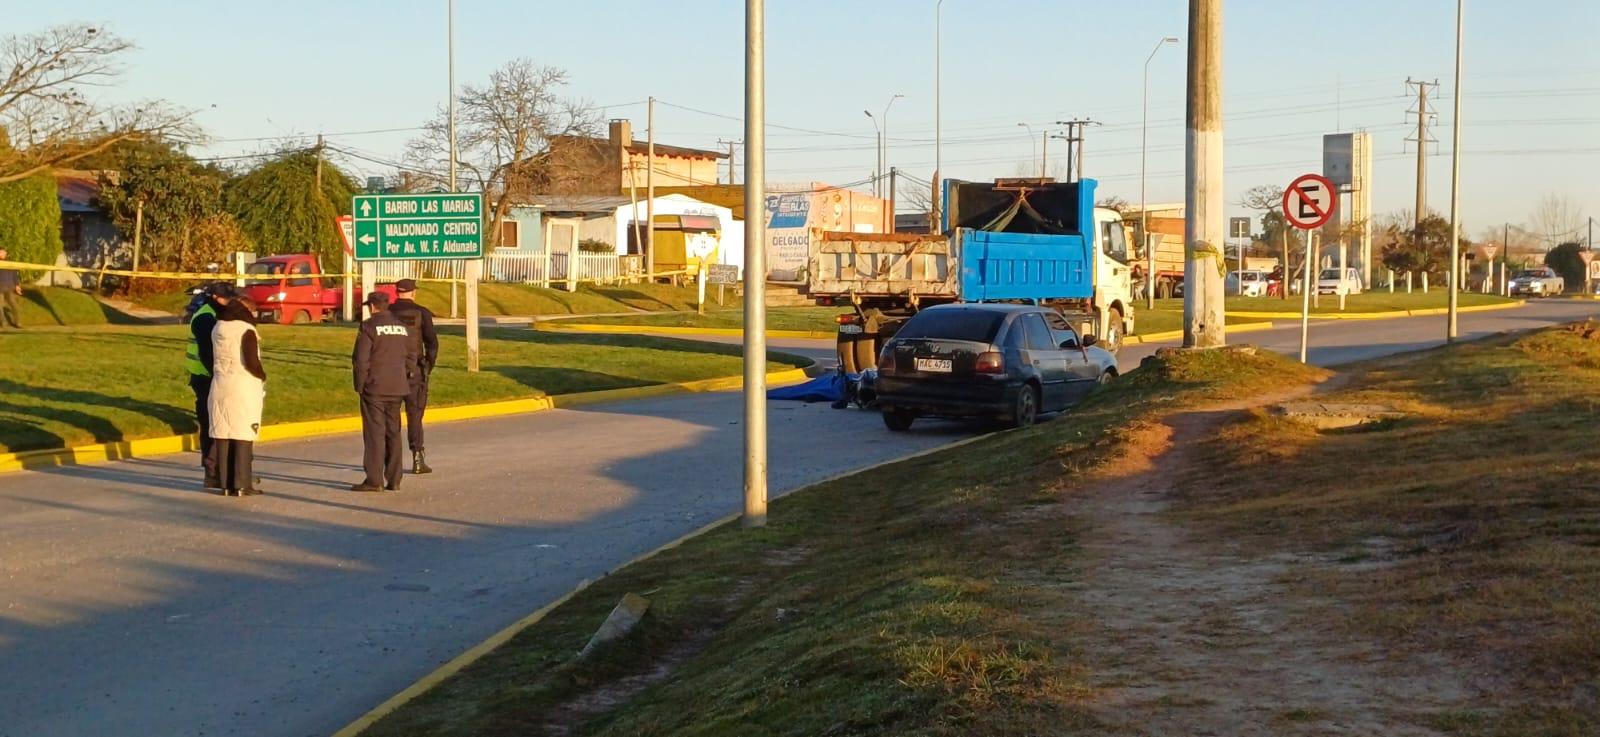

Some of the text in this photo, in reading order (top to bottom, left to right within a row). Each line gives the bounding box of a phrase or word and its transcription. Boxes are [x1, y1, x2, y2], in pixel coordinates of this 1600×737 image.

[385, 199, 475, 214] BARRIO LAS MARIAS
[1299, 186, 1319, 218] E
[385, 222, 477, 237] MALDONADO CENTRO
[386, 240, 477, 254] Por Av. W. F. Aldunate
[772, 236, 808, 246] DELGADO
[375, 325, 409, 336] POLICIA
